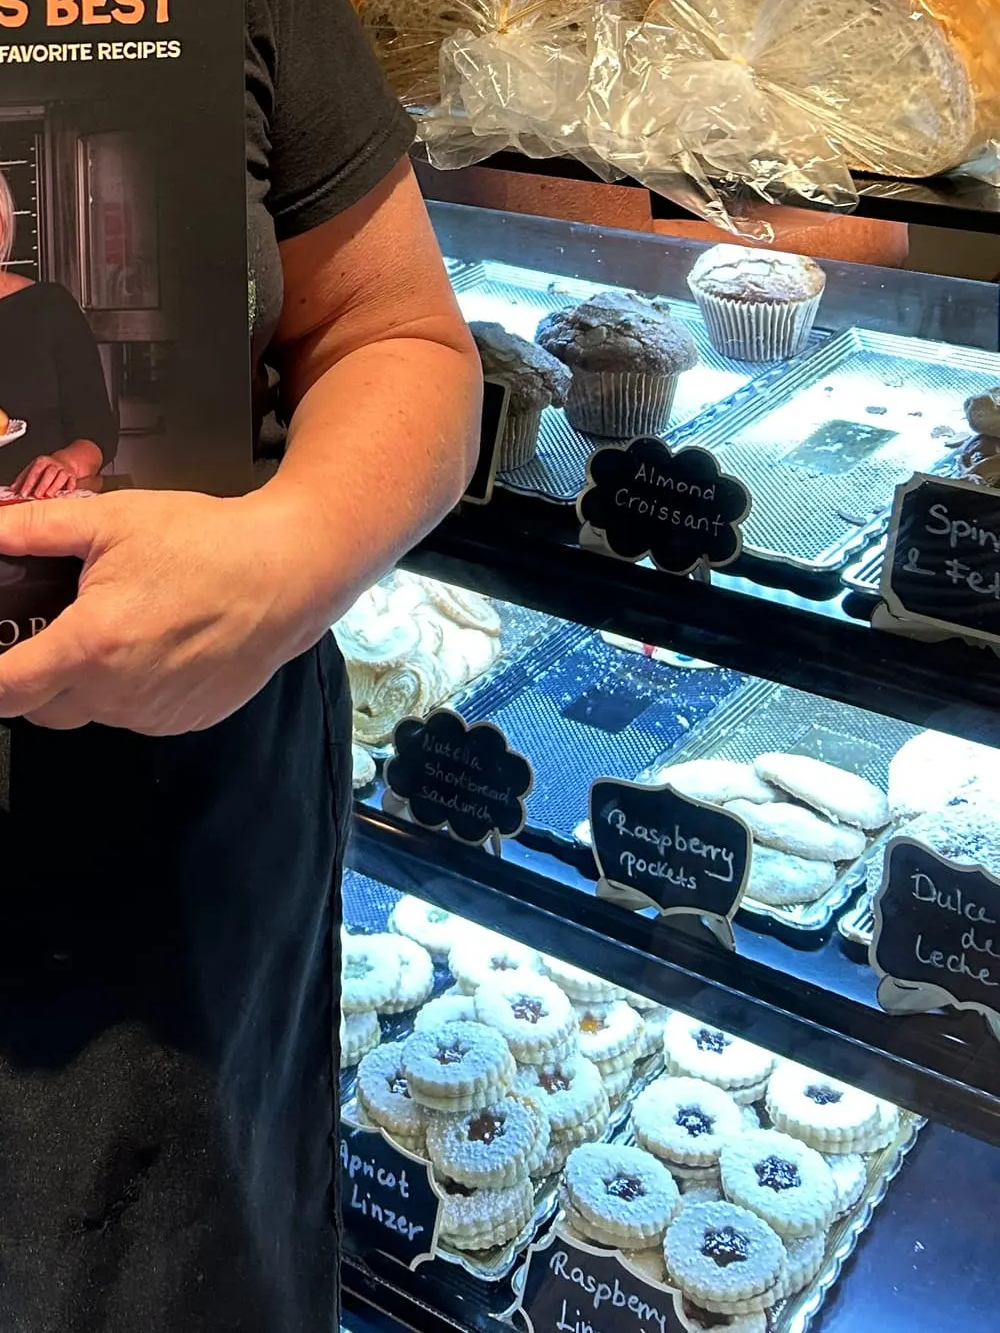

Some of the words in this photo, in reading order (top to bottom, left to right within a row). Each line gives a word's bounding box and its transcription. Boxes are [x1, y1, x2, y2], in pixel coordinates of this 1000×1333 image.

[97, 40, 181, 61] RECIPES
[634, 462, 716, 501] Almond
[615, 488, 725, 537] Croissant
[607, 808, 734, 882] Raspberry
[910, 870, 997, 924] Dulce
[349, 1183, 424, 1242] Linzer
[549, 1250, 666, 1333] Raspberry
